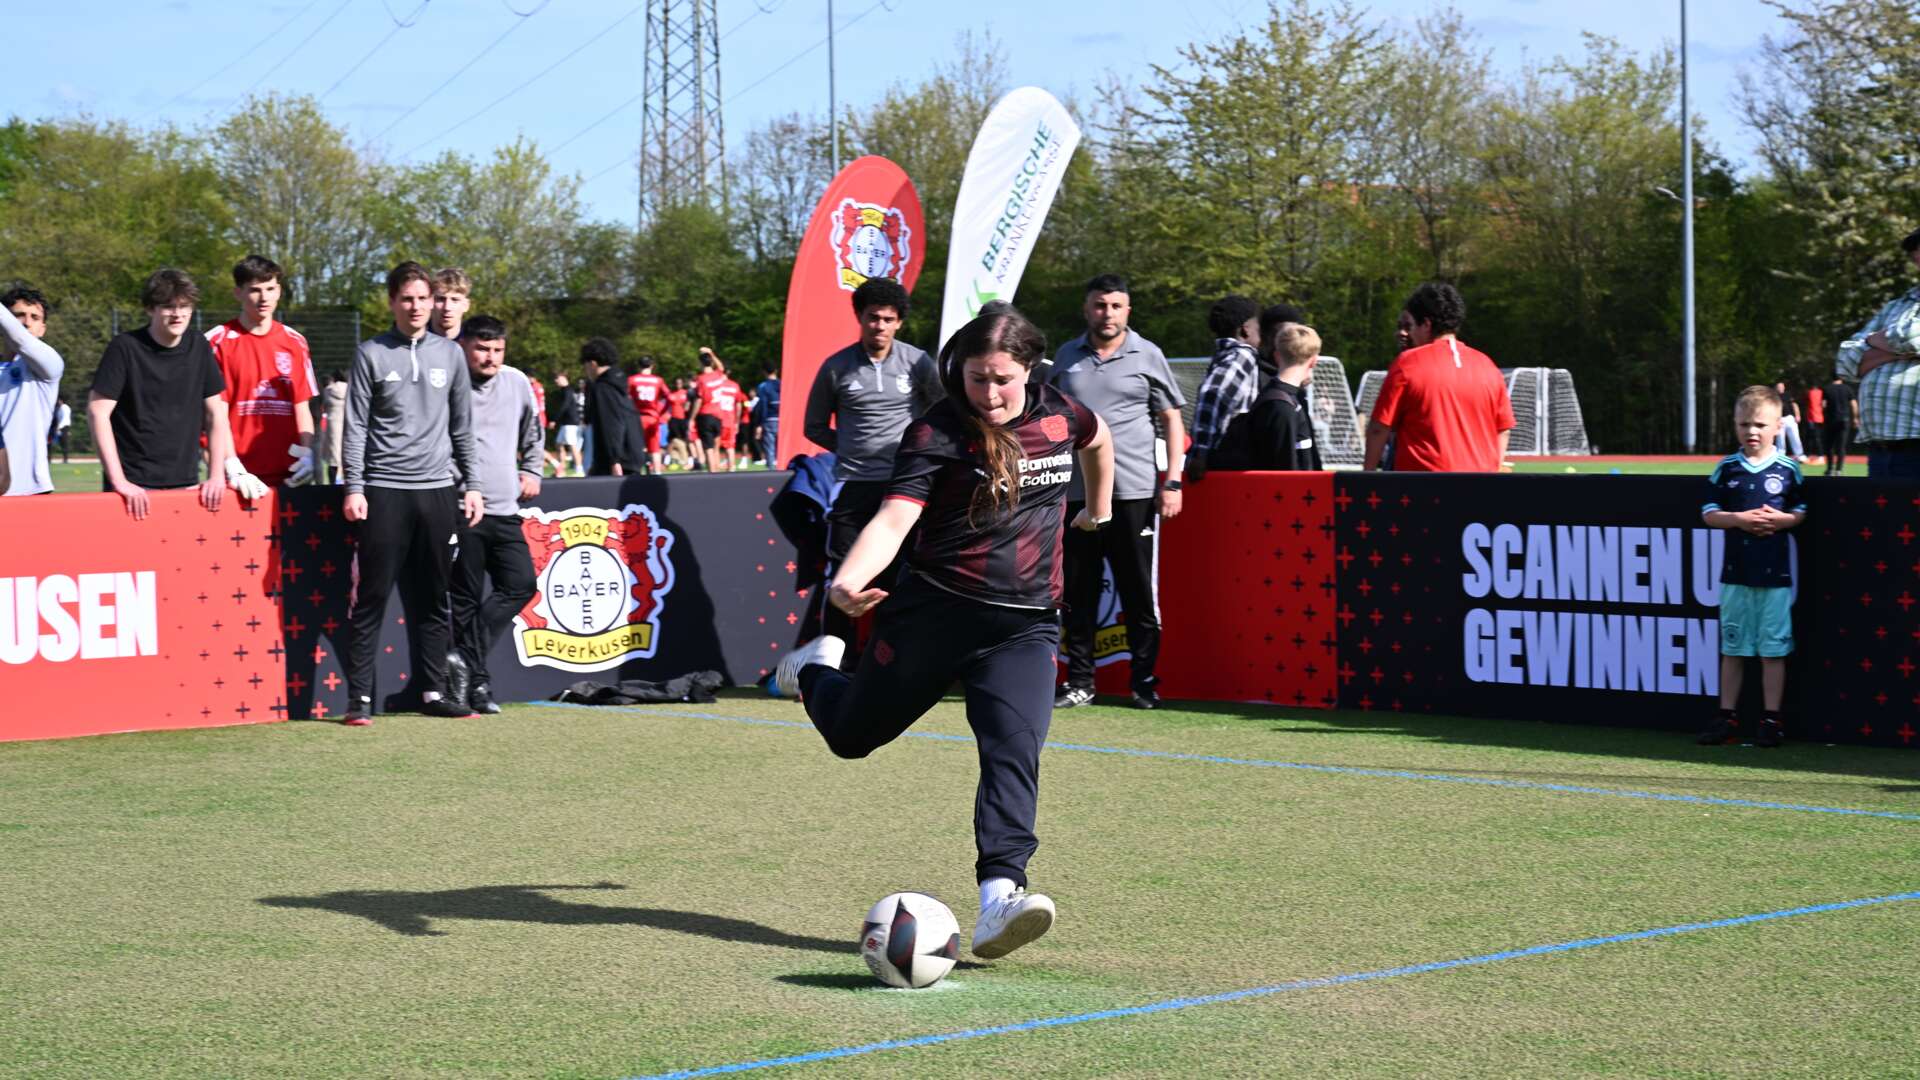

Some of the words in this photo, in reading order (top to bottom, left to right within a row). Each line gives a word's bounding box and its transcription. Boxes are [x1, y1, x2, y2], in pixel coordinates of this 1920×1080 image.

[982, 119, 1052, 272] BERGISCHE
[564, 523, 603, 540] 1904
[1461, 522, 1683, 605] SCANNEN
[553, 581, 620, 599] BAYER
[580, 551, 595, 630] BAYER
[533, 632, 642, 658] Leverkusen
[1463, 608, 1720, 697] GEWINNEN
